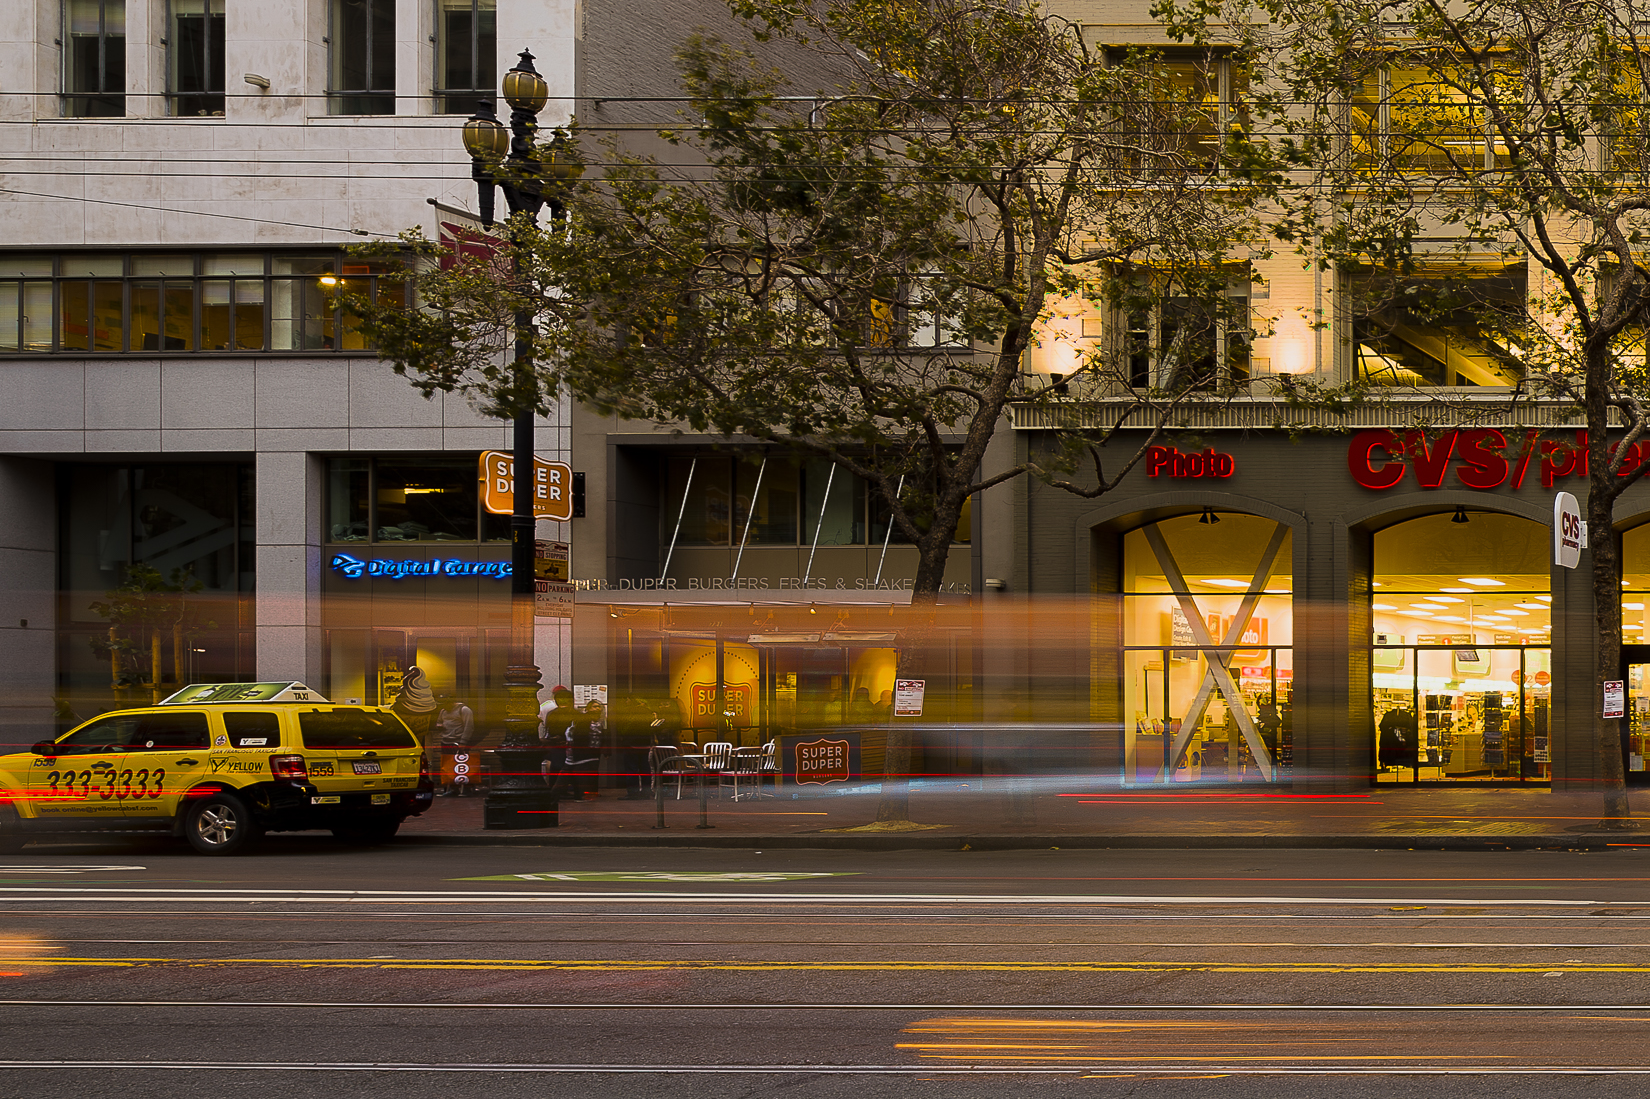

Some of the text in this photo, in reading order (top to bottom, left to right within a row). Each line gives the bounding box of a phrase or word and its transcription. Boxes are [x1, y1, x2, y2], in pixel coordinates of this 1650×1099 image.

[1146, 445, 1235, 478] Photo
[496, 461, 562, 484] SER
[496, 478, 562, 501] DER
[1562, 511, 1580, 540] CVS
[545, 552, 567, 560] STOPPING
[366, 558, 513, 579] Digital Garage
[535, 583, 574, 594] NO PARKING
[619, 577, 677, 591] DUPER
[688, 577, 769, 591] BURGERS
[779, 577, 827, 591] FRIES
[835, 577, 846, 591] &
[855, 577, 916, 591] SHAKE
[1242, 630, 1258, 644] oto
[293, 692, 309, 701] TAXI
[698, 689, 744, 702] SUER
[698, 703, 744, 716] DUER
[802, 746, 843, 759] SUPER
[33, 758, 57, 767] 1559
[227, 762, 264, 771] YELLOW
[802, 757, 843, 771] DUPER
[307, 766, 335, 777] 1559
[46, 768, 166, 801] 333-3333
[62, 805, 158, 813] online@yellowcabsf.com
